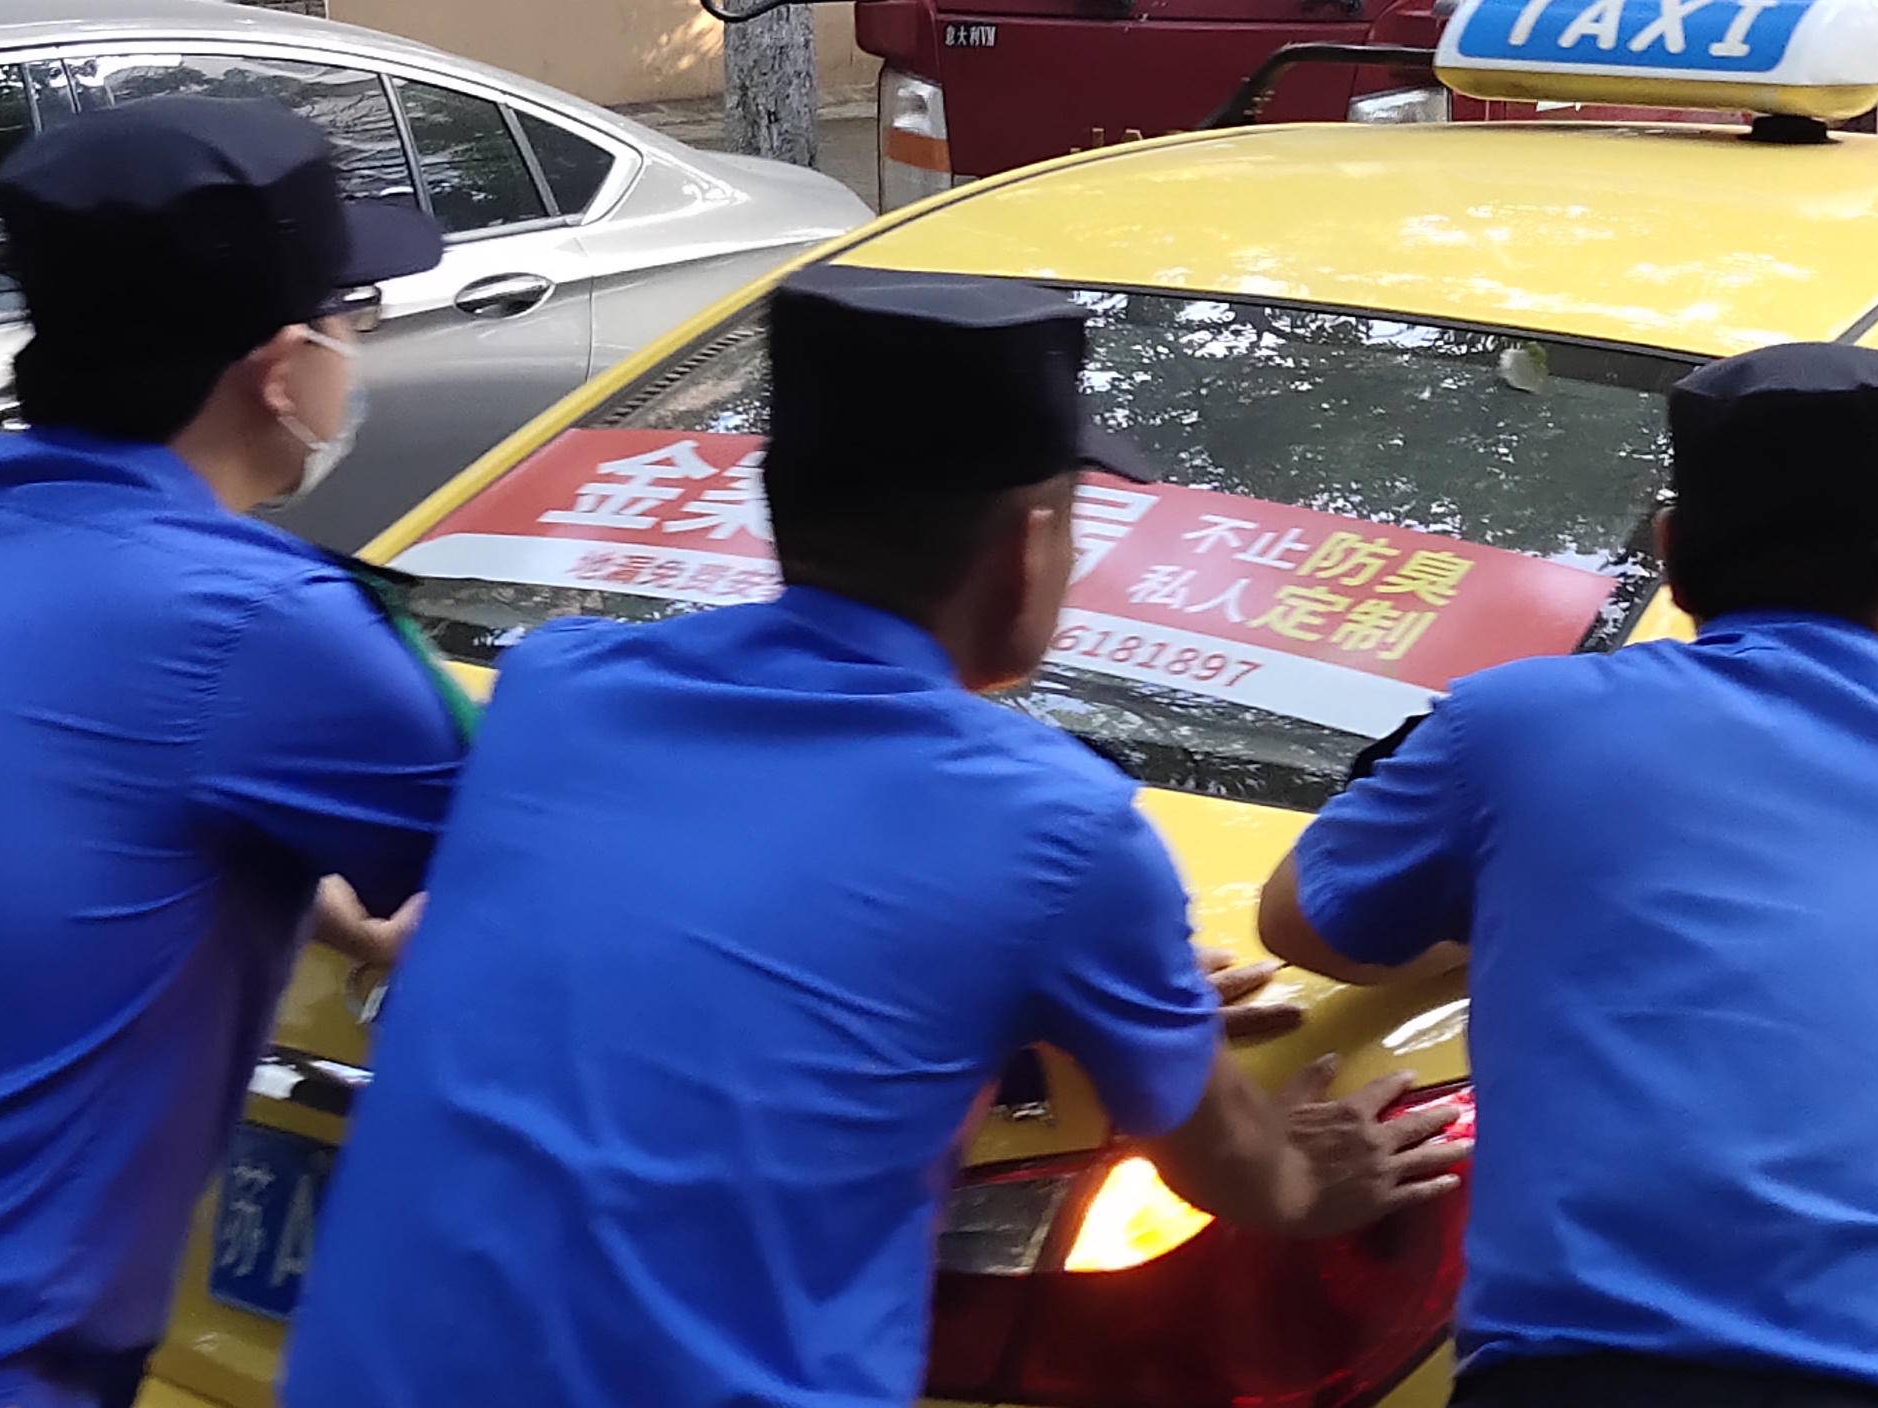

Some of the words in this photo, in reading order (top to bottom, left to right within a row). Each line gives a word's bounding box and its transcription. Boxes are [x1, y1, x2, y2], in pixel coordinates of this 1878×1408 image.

[1181, 513, 1476, 606] 不止防臭
[1051, 624, 1263, 688] 6181897
[1128, 563, 1438, 661] 私人定制
